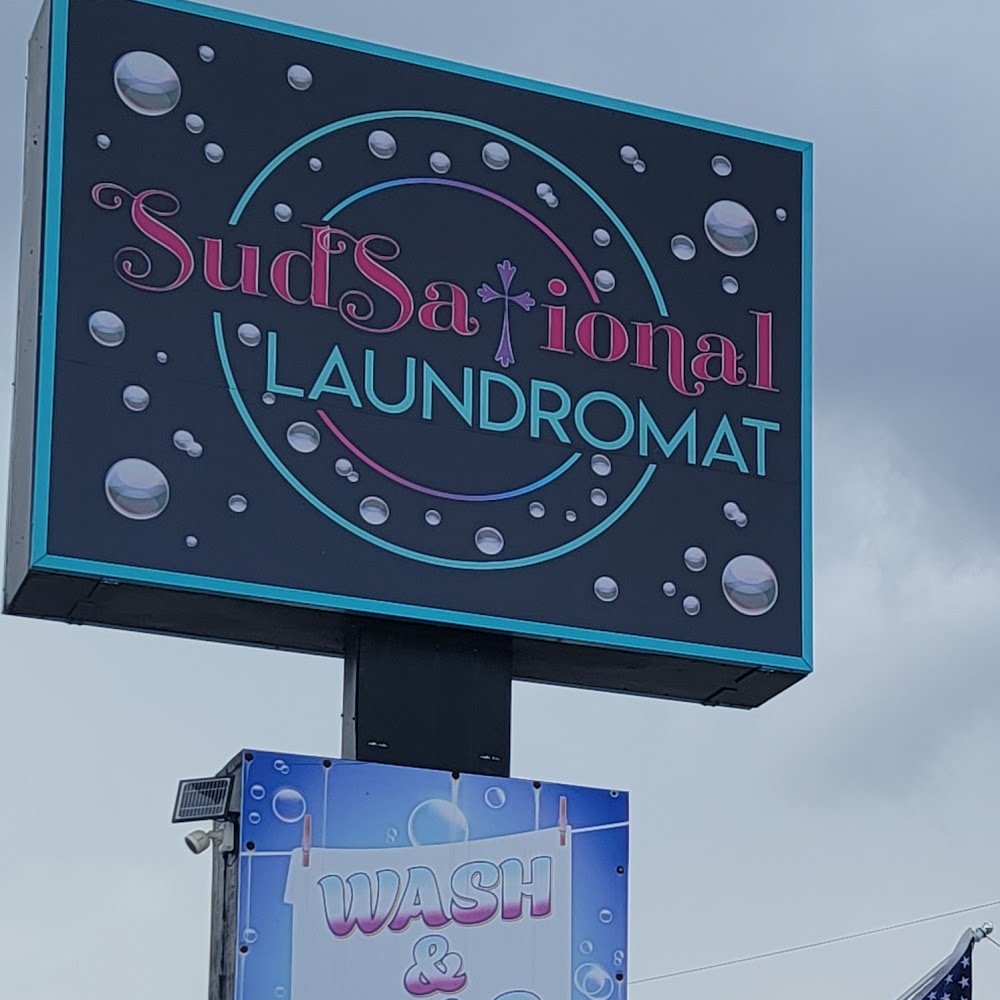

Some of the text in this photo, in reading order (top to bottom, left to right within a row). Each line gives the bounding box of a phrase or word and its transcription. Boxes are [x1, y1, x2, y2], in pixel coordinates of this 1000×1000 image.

[266, 331, 781, 477] LAUNDROMAT
[318, 855, 553, 938] WASH
[403, 934, 467, 997] &
